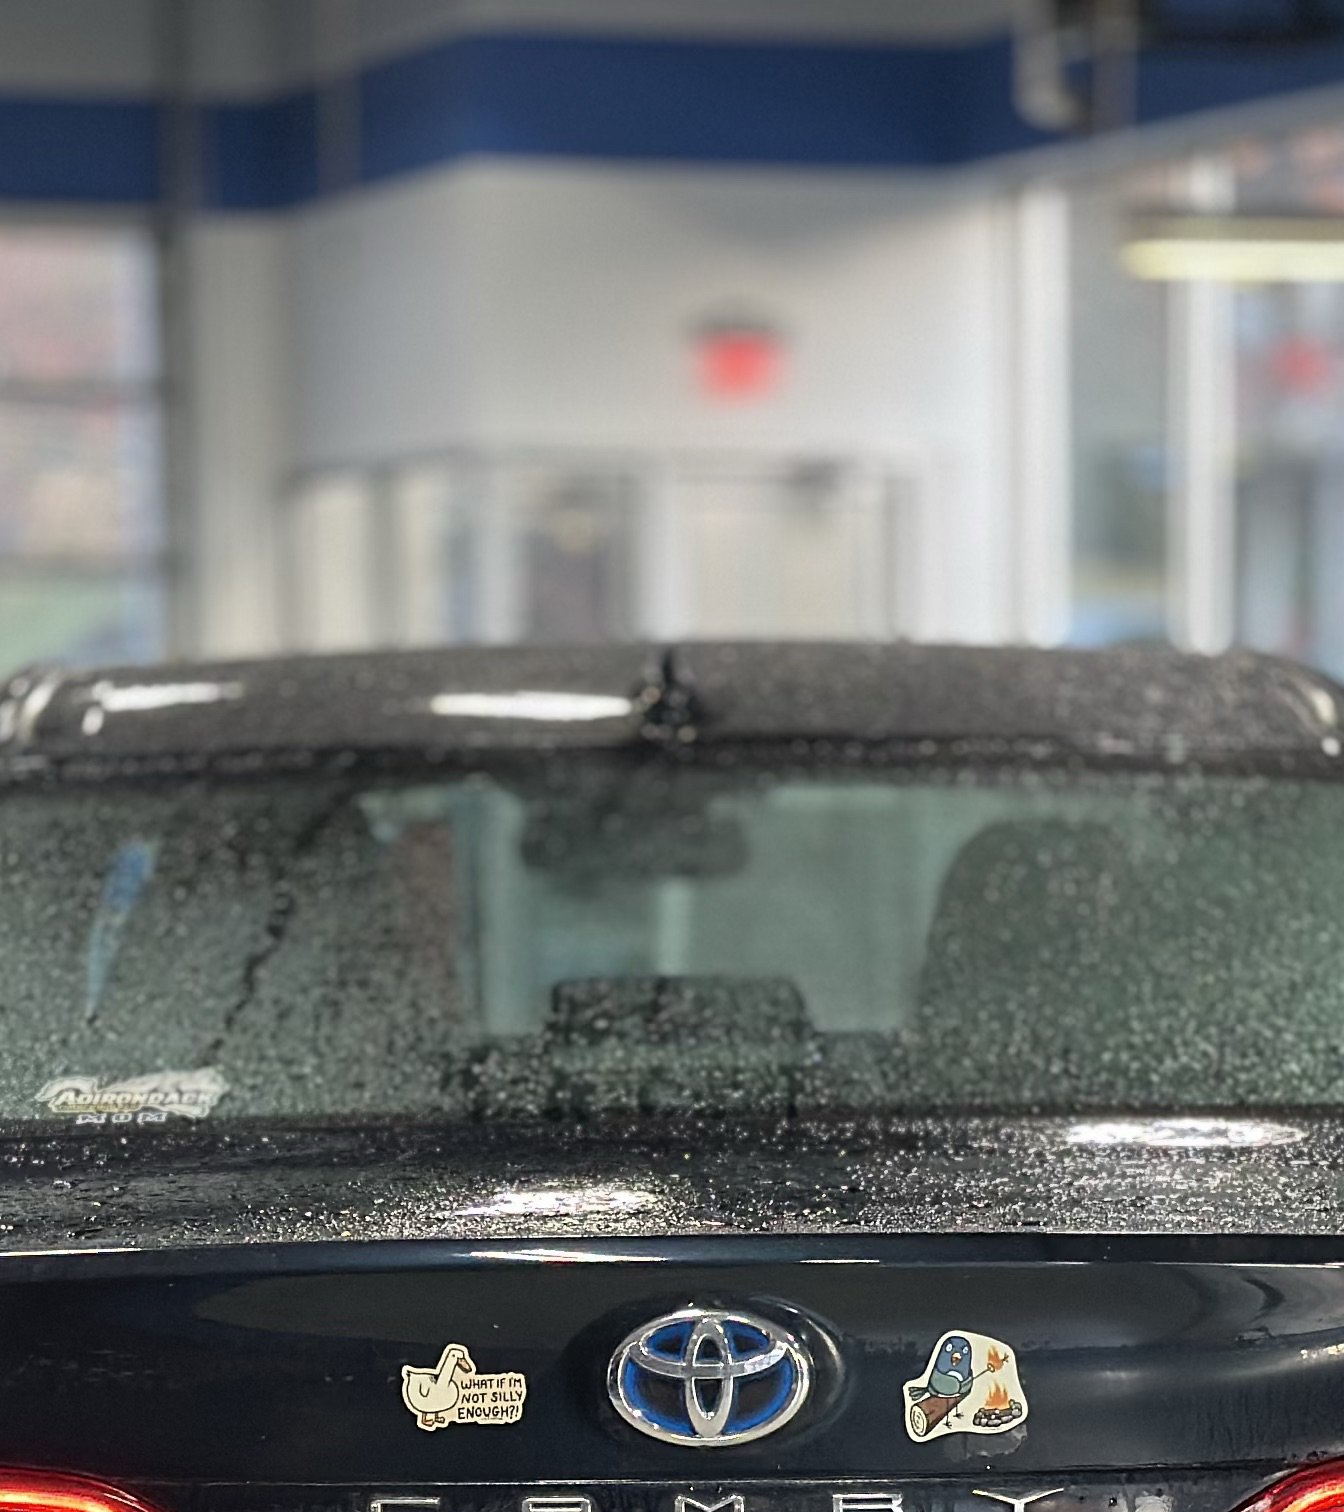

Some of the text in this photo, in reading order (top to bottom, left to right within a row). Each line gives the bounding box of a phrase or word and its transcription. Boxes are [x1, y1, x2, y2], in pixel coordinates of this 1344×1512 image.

[76, 1113, 168, 1125] MOM
[461, 1377, 522, 1389] WHAT IF I'M
[461, 1391, 523, 1404] NOT SILLY
[458, 1405, 519, 1420] ENOUGH?!
